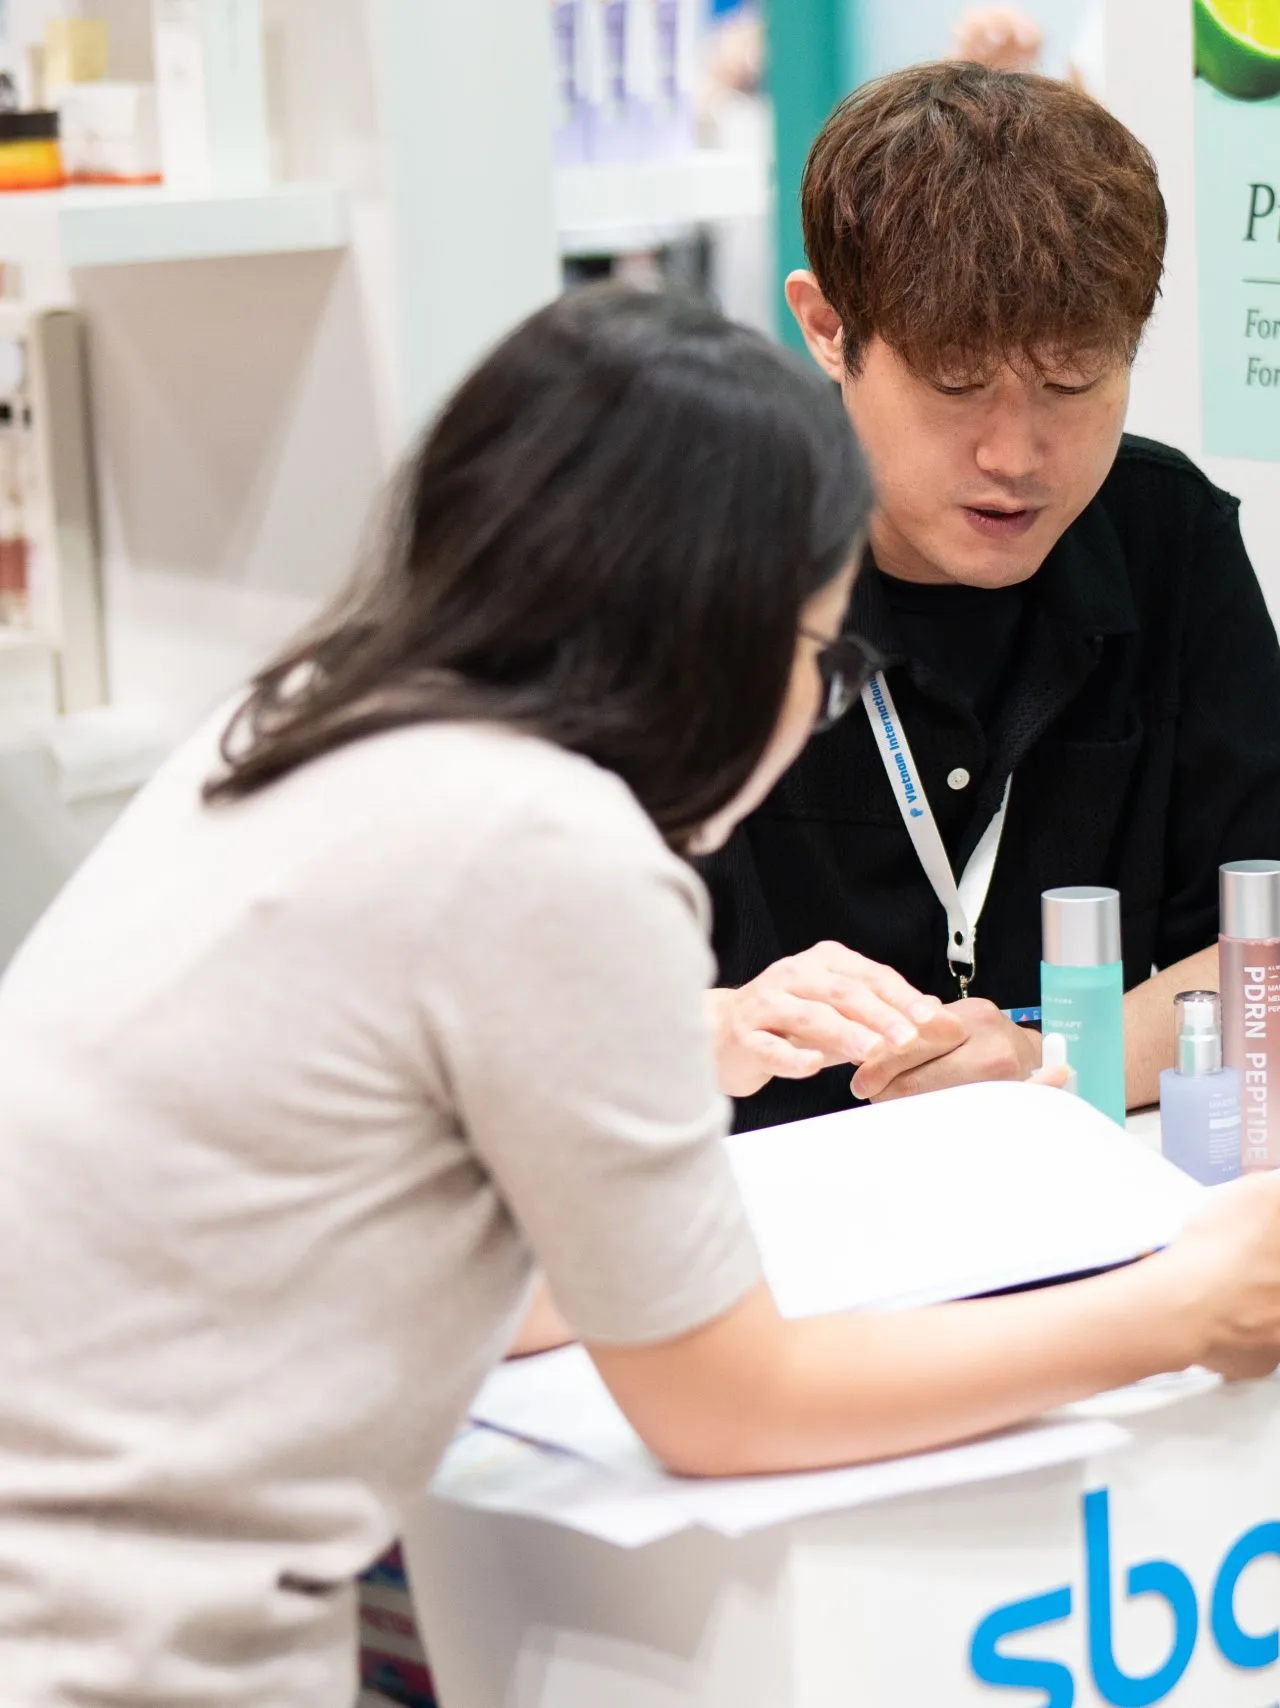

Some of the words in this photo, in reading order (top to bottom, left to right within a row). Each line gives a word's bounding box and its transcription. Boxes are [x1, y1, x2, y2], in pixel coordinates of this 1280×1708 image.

[894, 752, 918, 804] Vietnam
[1244, 966, 1267, 1039] PDRN
[1246, 1053, 1268, 1160] PEPTIDE
